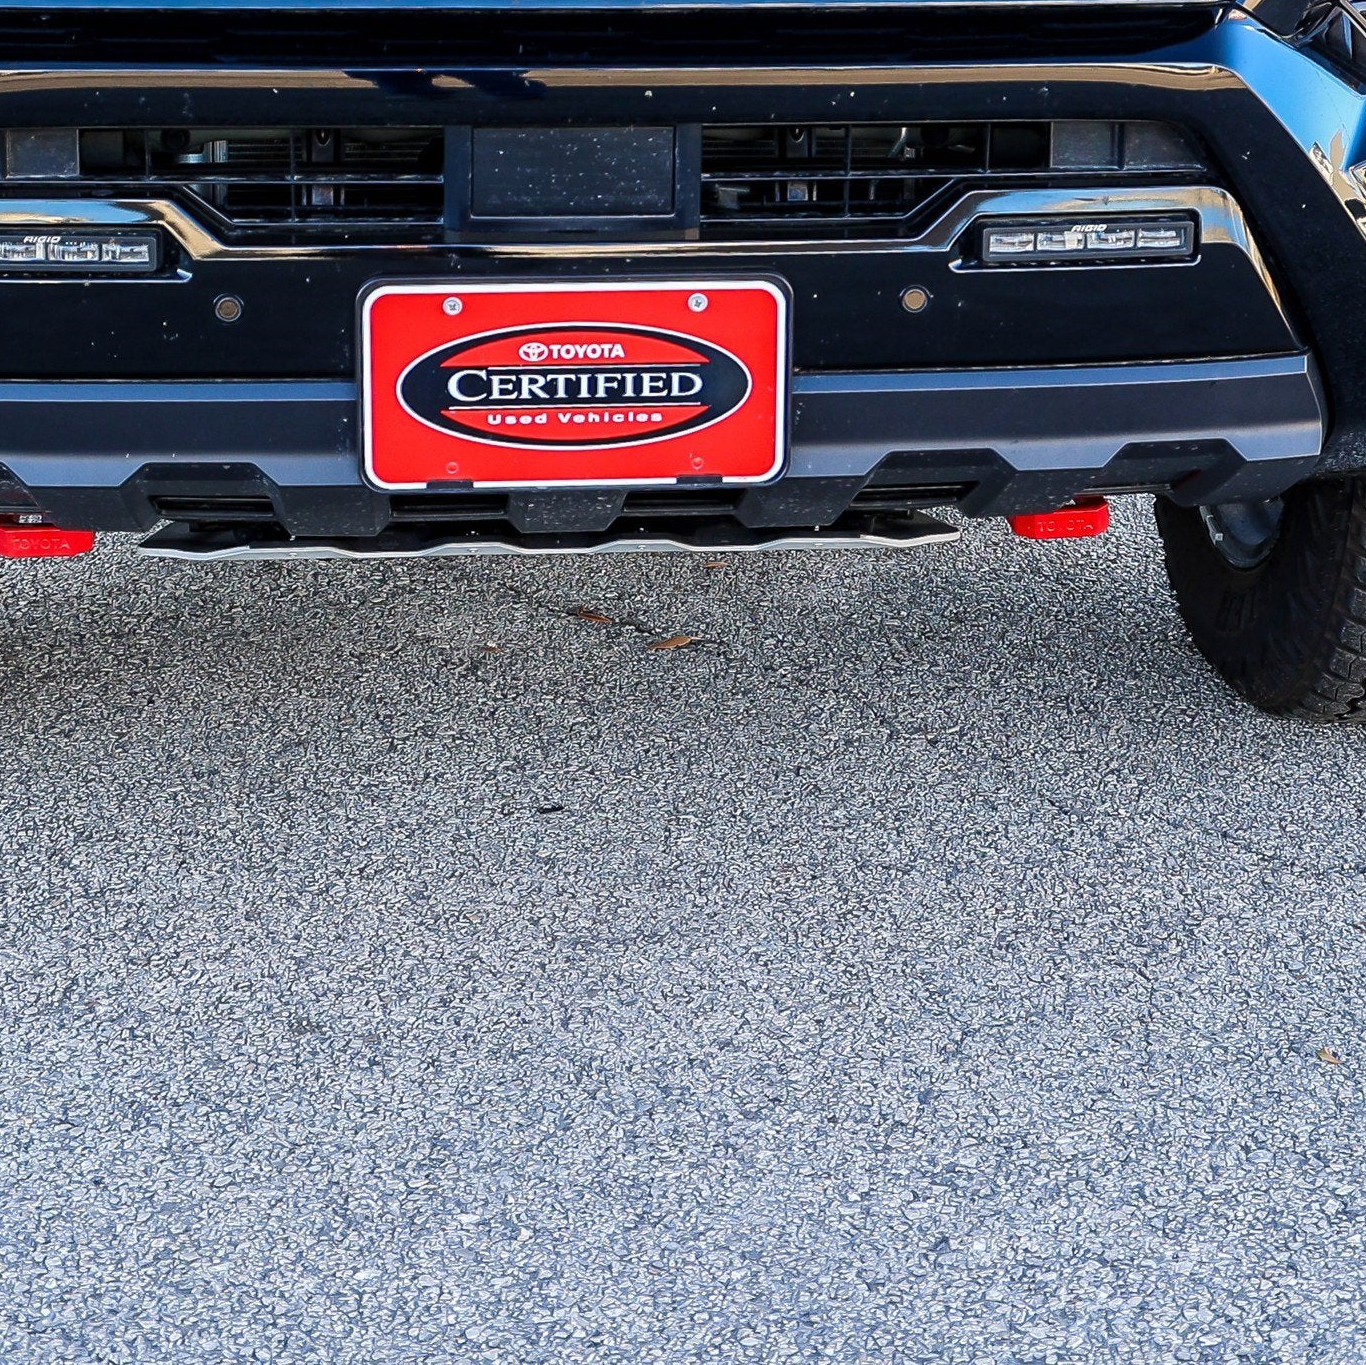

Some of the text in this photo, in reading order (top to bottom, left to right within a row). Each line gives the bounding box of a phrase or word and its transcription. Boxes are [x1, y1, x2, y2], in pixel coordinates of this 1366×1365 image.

[1071, 224, 1108, 233] RIGID
[23, 235, 62, 244] RIGID
[548, 343, 626, 360] TOYOTA
[447, 369, 704, 402] CERTIFIED
[487, 409, 664, 426] Used Vehicles
[1036, 518, 1094, 533] TOOTA
[10, 537, 72, 552] TOYOTA
